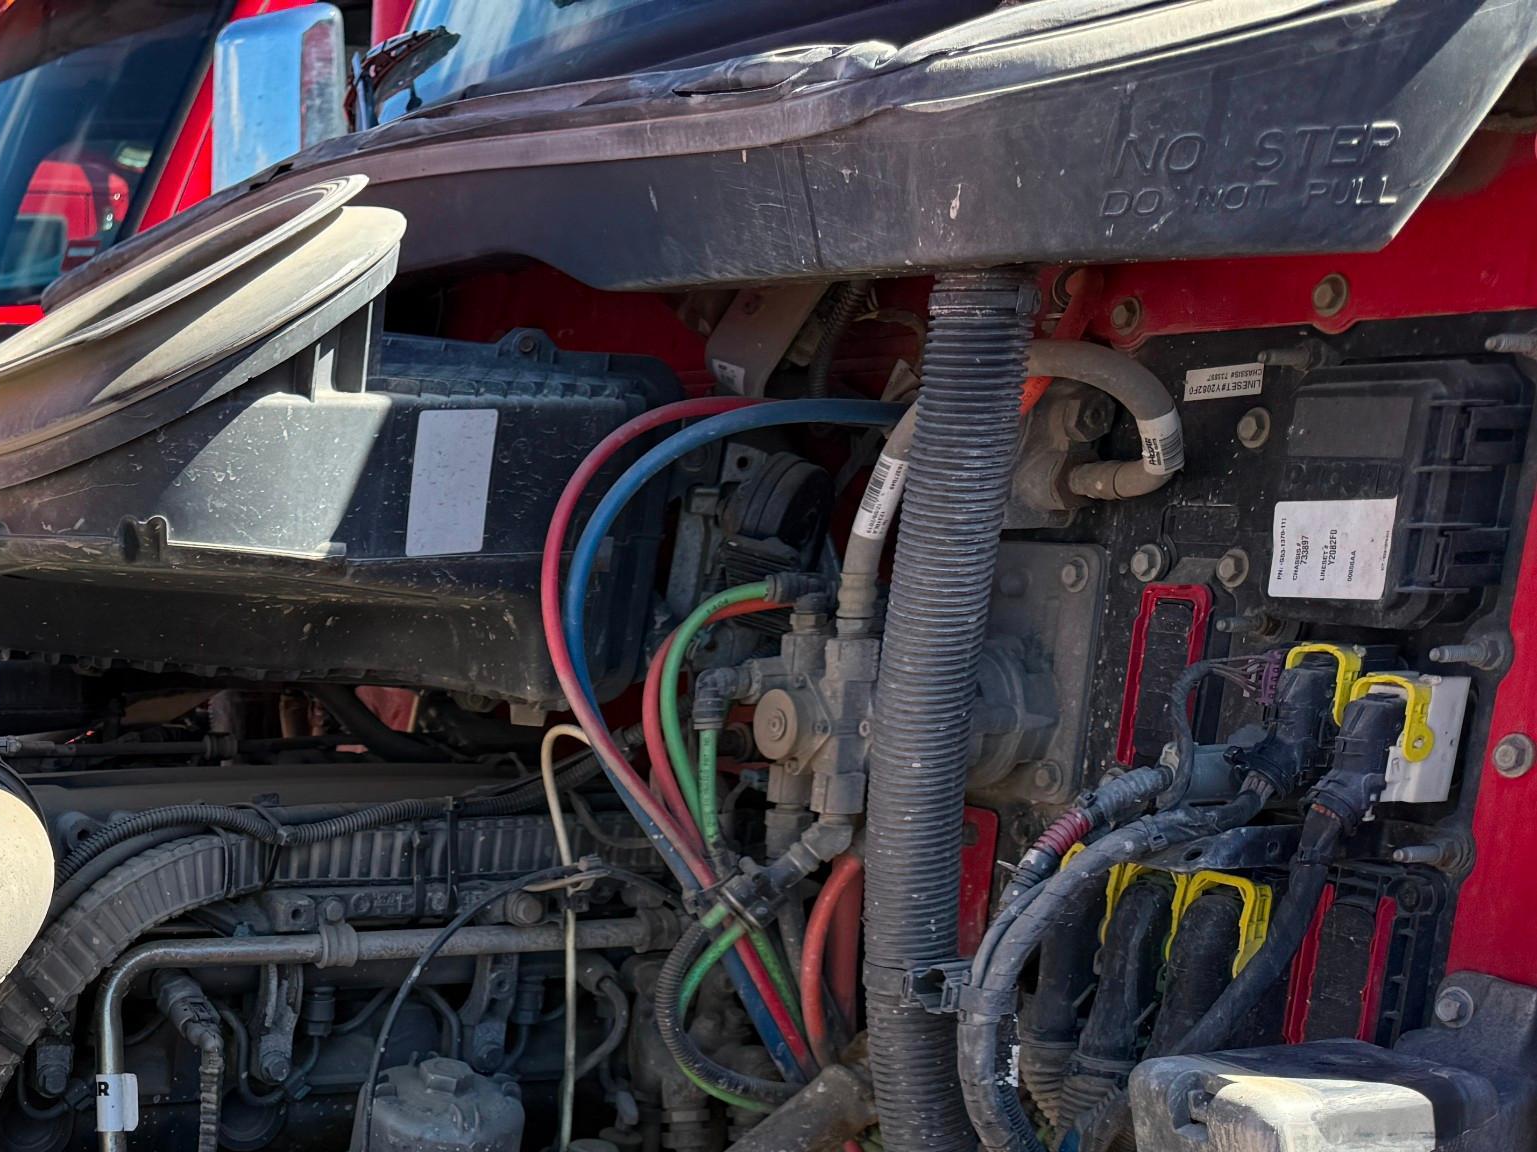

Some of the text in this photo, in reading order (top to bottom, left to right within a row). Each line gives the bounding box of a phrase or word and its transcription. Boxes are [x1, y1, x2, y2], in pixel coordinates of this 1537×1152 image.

[1112, 119, 1402, 179] NO STEP
[1099, 175, 1399, 218] DO NOT PULL
[1300, 535, 1310, 565] 733897
